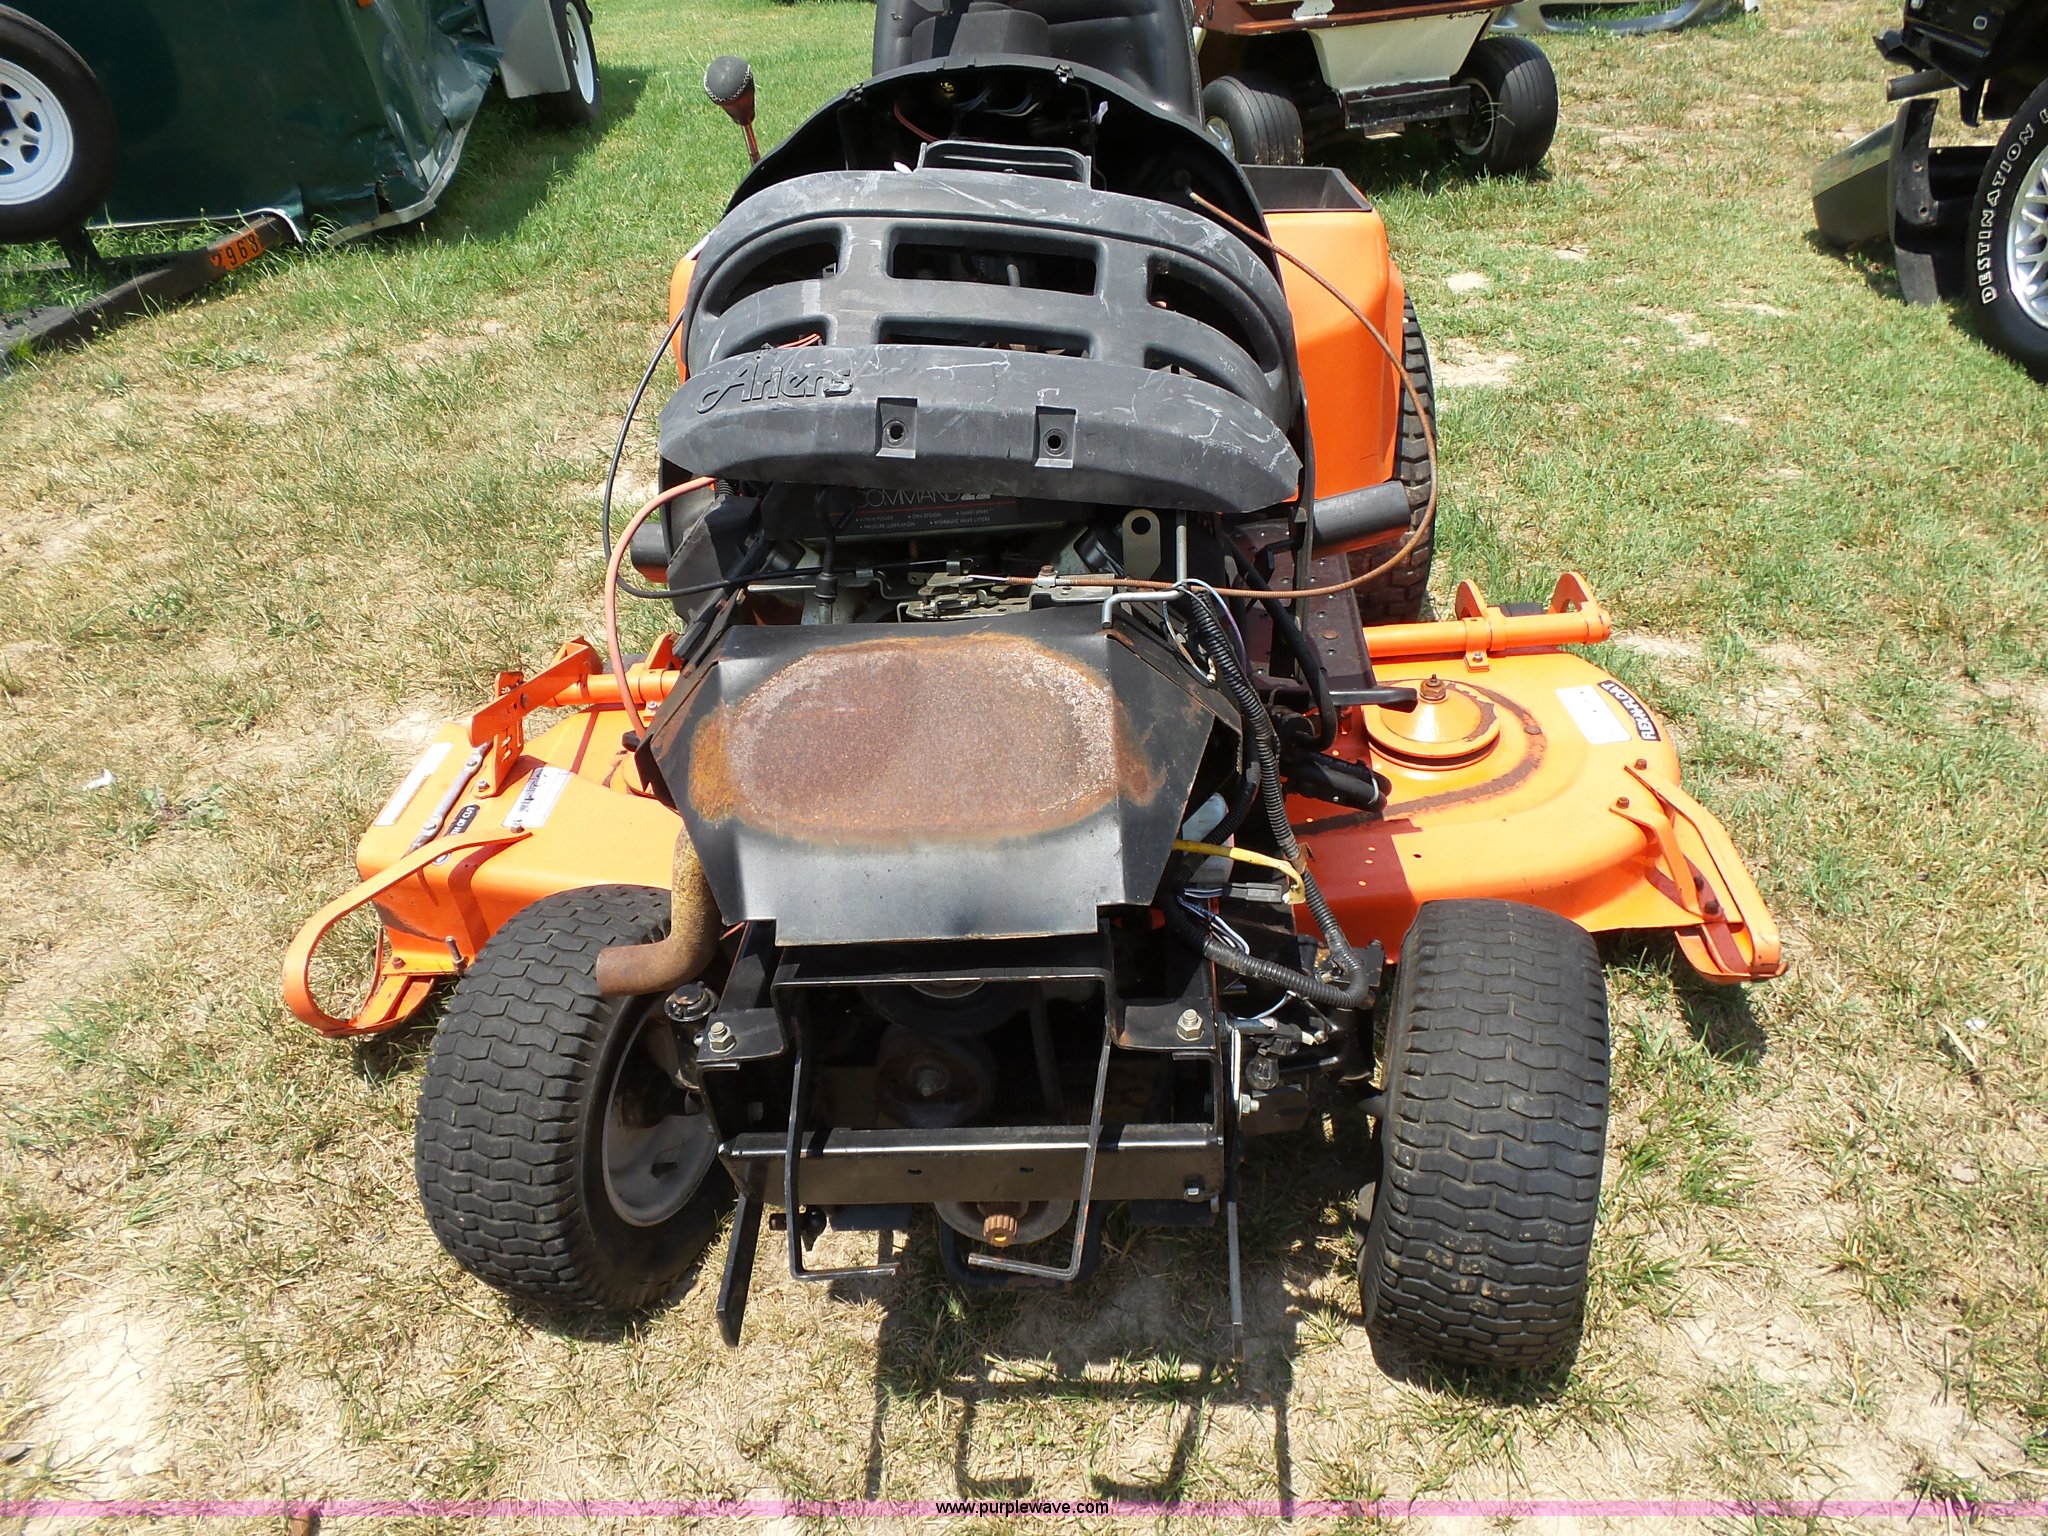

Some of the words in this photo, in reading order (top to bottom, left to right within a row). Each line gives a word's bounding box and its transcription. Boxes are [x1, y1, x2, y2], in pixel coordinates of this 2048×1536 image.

[1977, 123, 2034, 304] DESTINATION
[696, 361, 853, 413] Ariens
[462, 807, 475, 818] CUT
